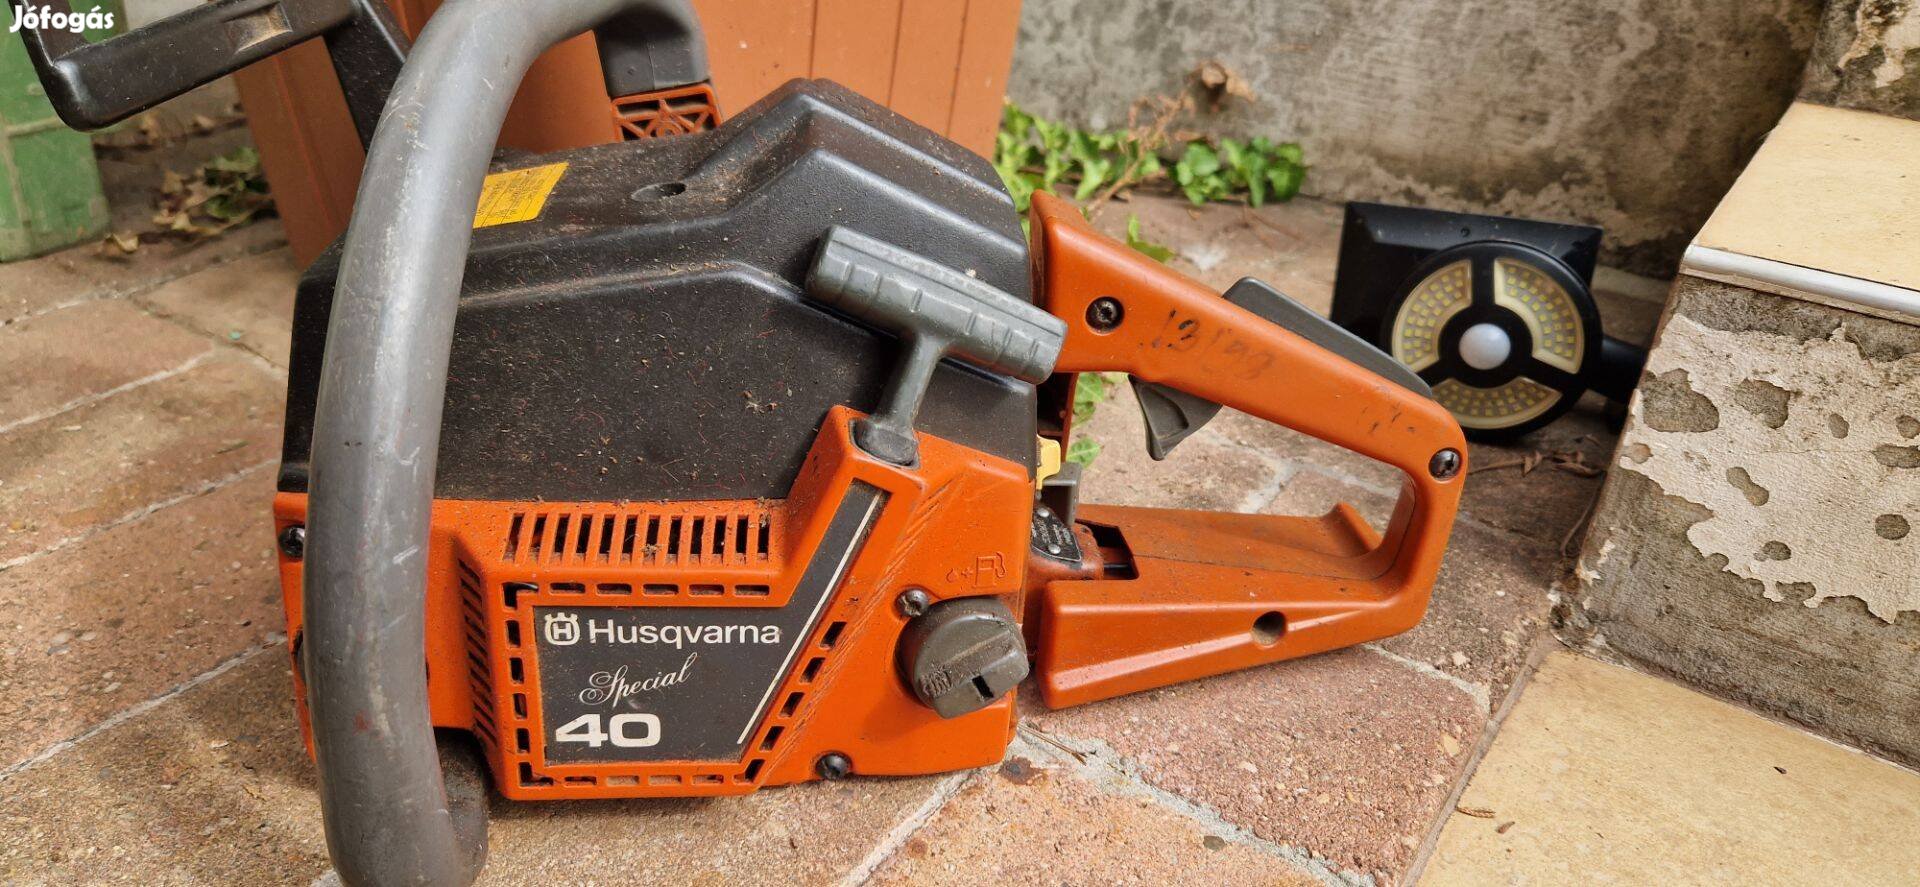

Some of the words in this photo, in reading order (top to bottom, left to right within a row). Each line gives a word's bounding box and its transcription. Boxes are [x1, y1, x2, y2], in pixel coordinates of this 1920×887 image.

[588, 618, 781, 649] Husqvarna
[579, 652, 698, 708] Special
[555, 713, 662, 748] 40
